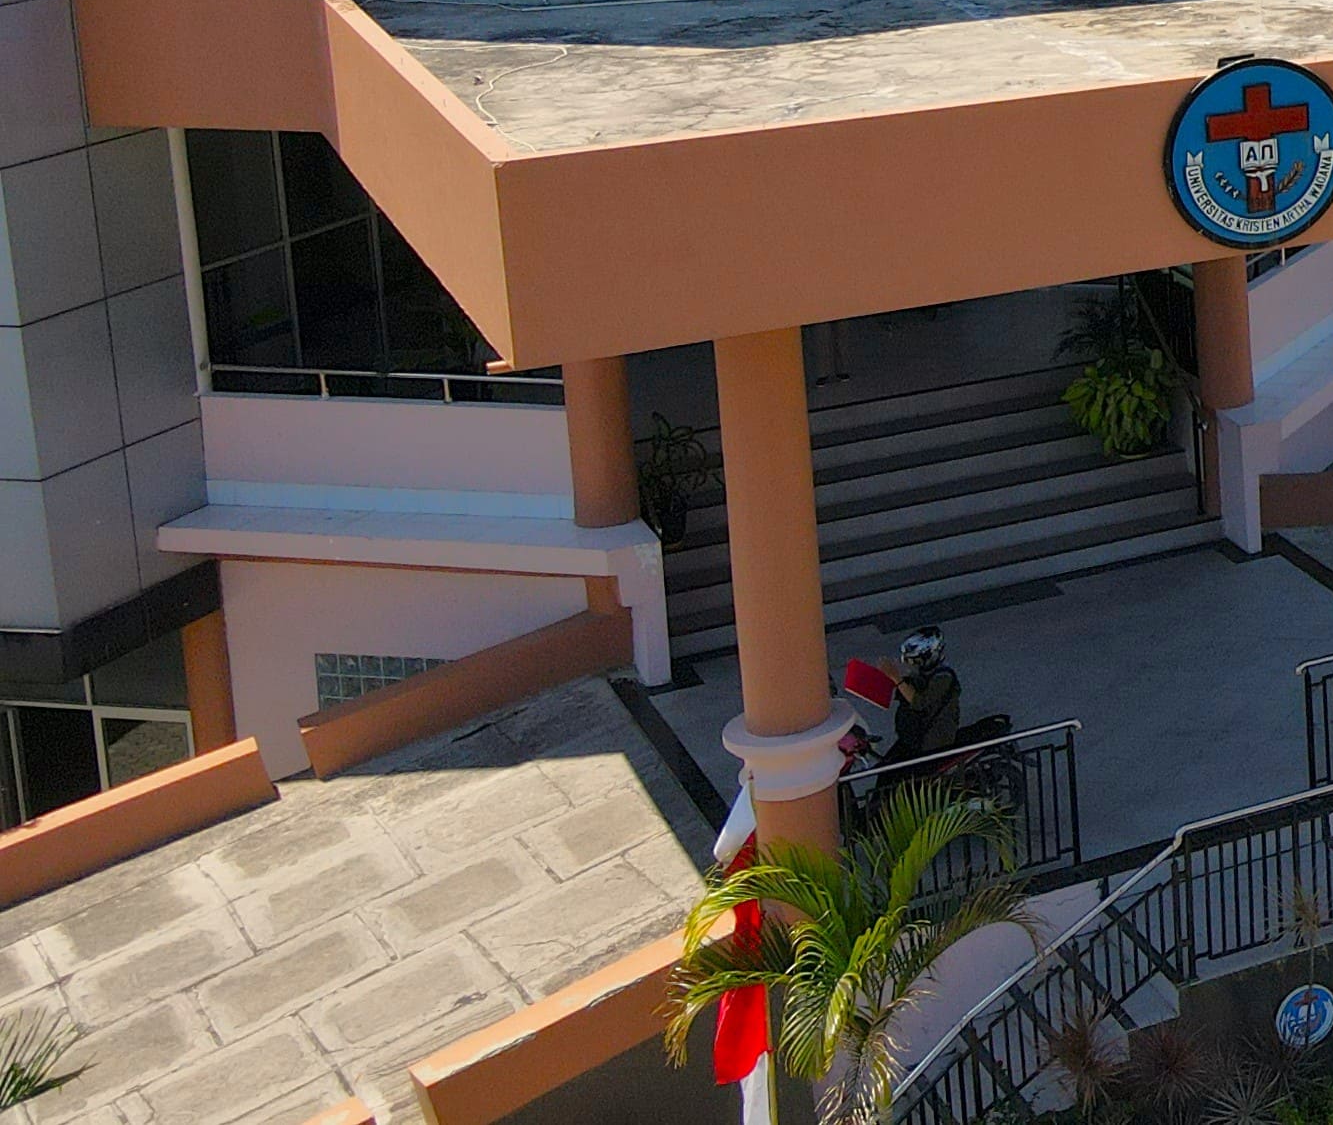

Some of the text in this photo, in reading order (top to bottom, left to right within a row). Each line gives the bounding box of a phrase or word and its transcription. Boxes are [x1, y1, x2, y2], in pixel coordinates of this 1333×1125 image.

[1187, 168, 1235, 228] UNIVERSITAS
[1236, 217, 1280, 232] KRISTEN
[1282, 198, 1312, 225] ARTHA
